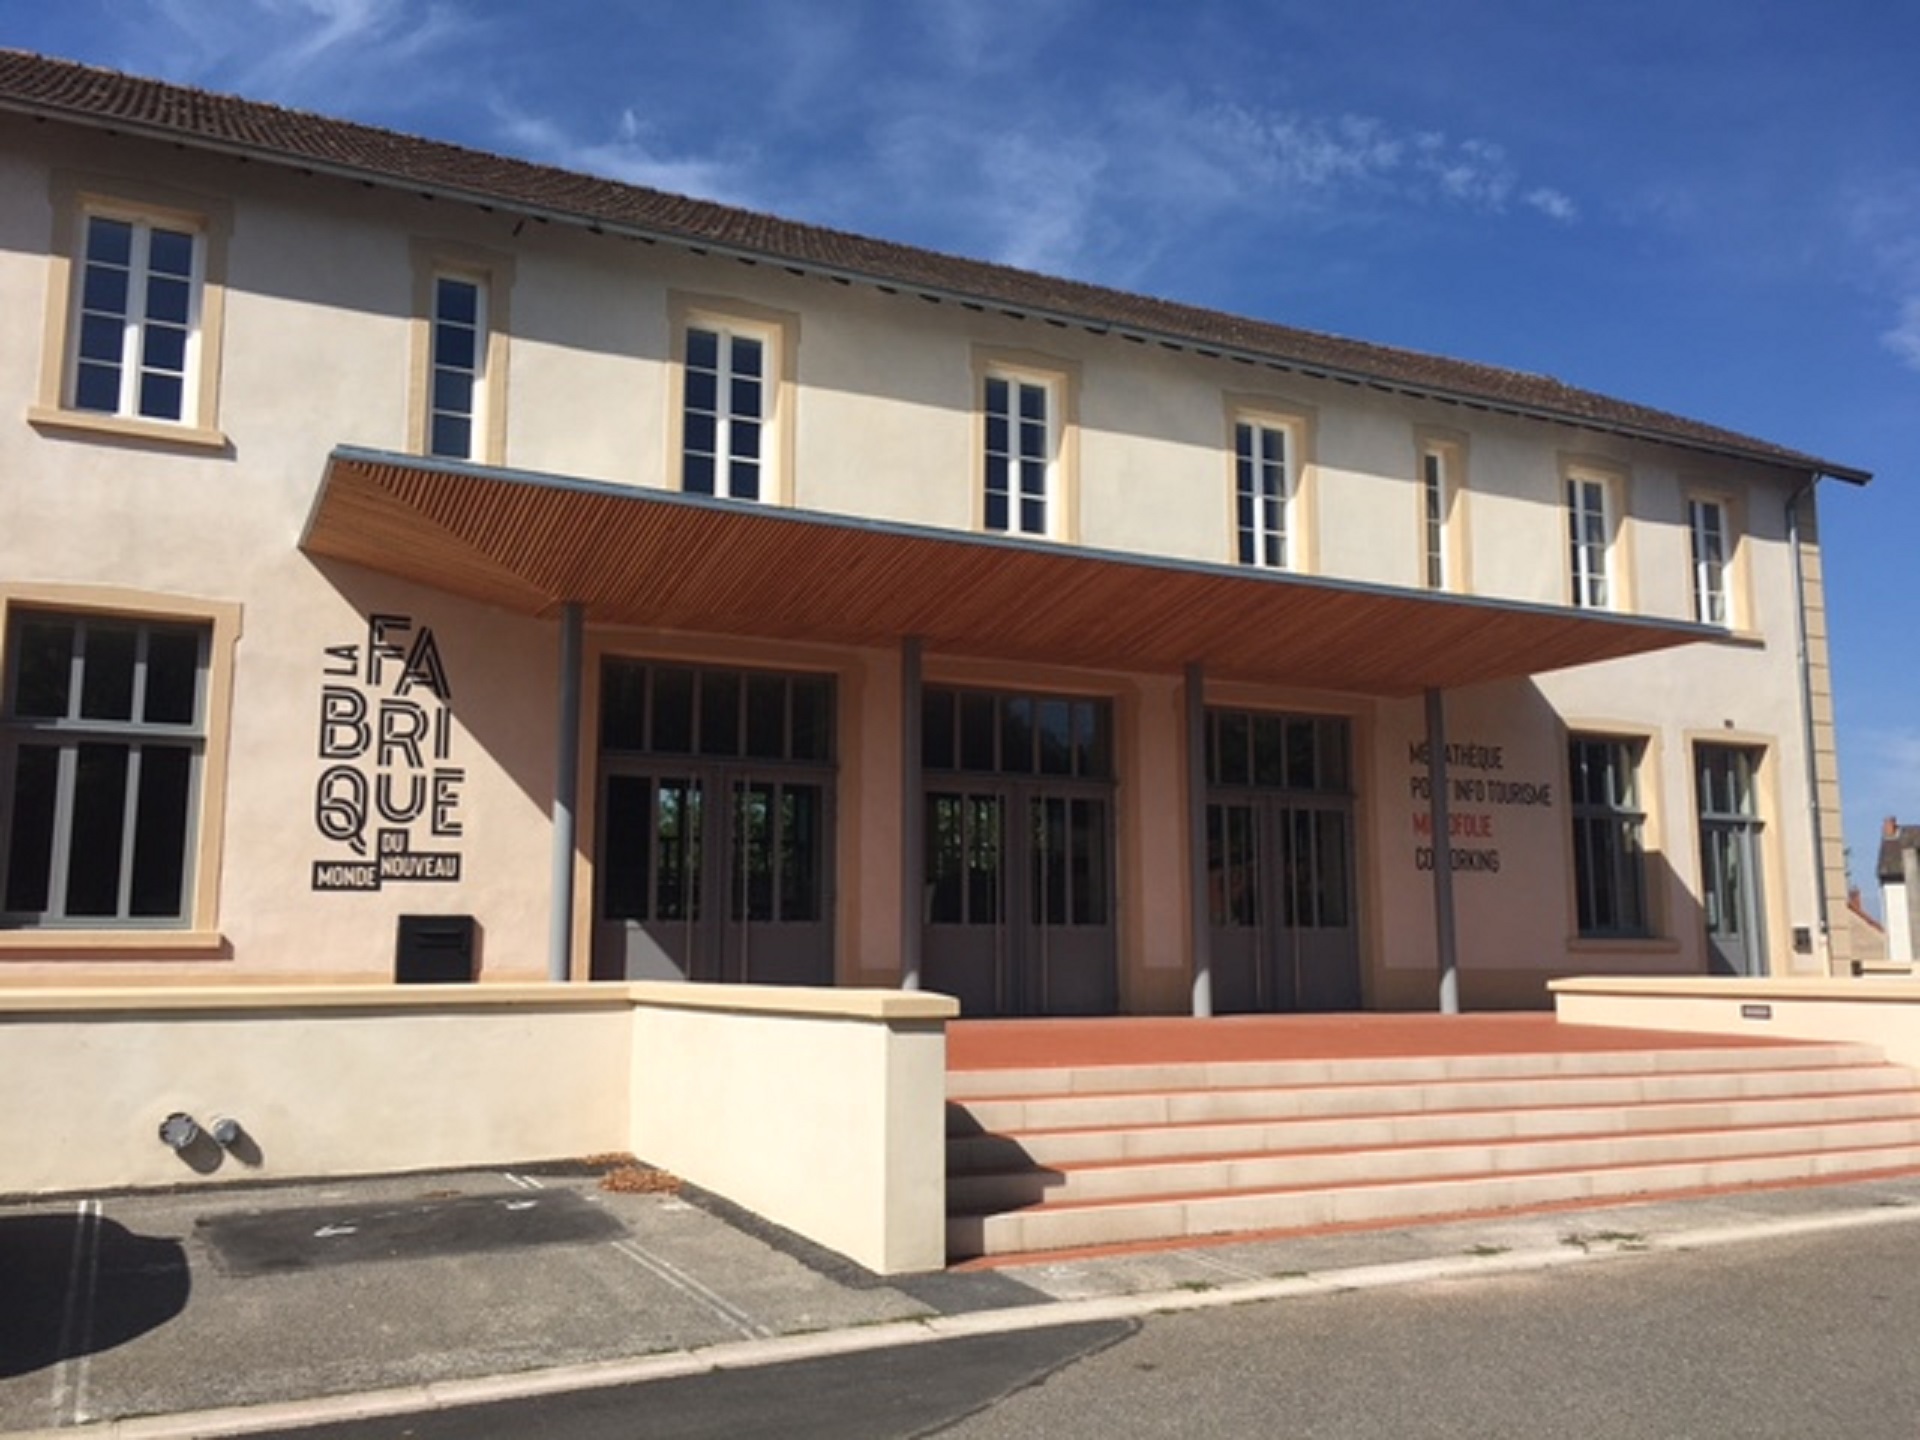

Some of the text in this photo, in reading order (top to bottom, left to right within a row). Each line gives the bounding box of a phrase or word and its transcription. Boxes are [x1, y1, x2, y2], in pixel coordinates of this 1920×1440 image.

[323, 644, 359, 677] LA
[1454, 778, 1485, 802] INFO
[1487, 780, 1552, 807] TOURISME
[1412, 812, 1493, 838] MOFOLIE
[381, 832, 406, 851] DU
[380, 855, 457, 878] NOUVEAU
[1415, 846, 1500, 873] COORKING
[316, 864, 377, 887] MONDE
